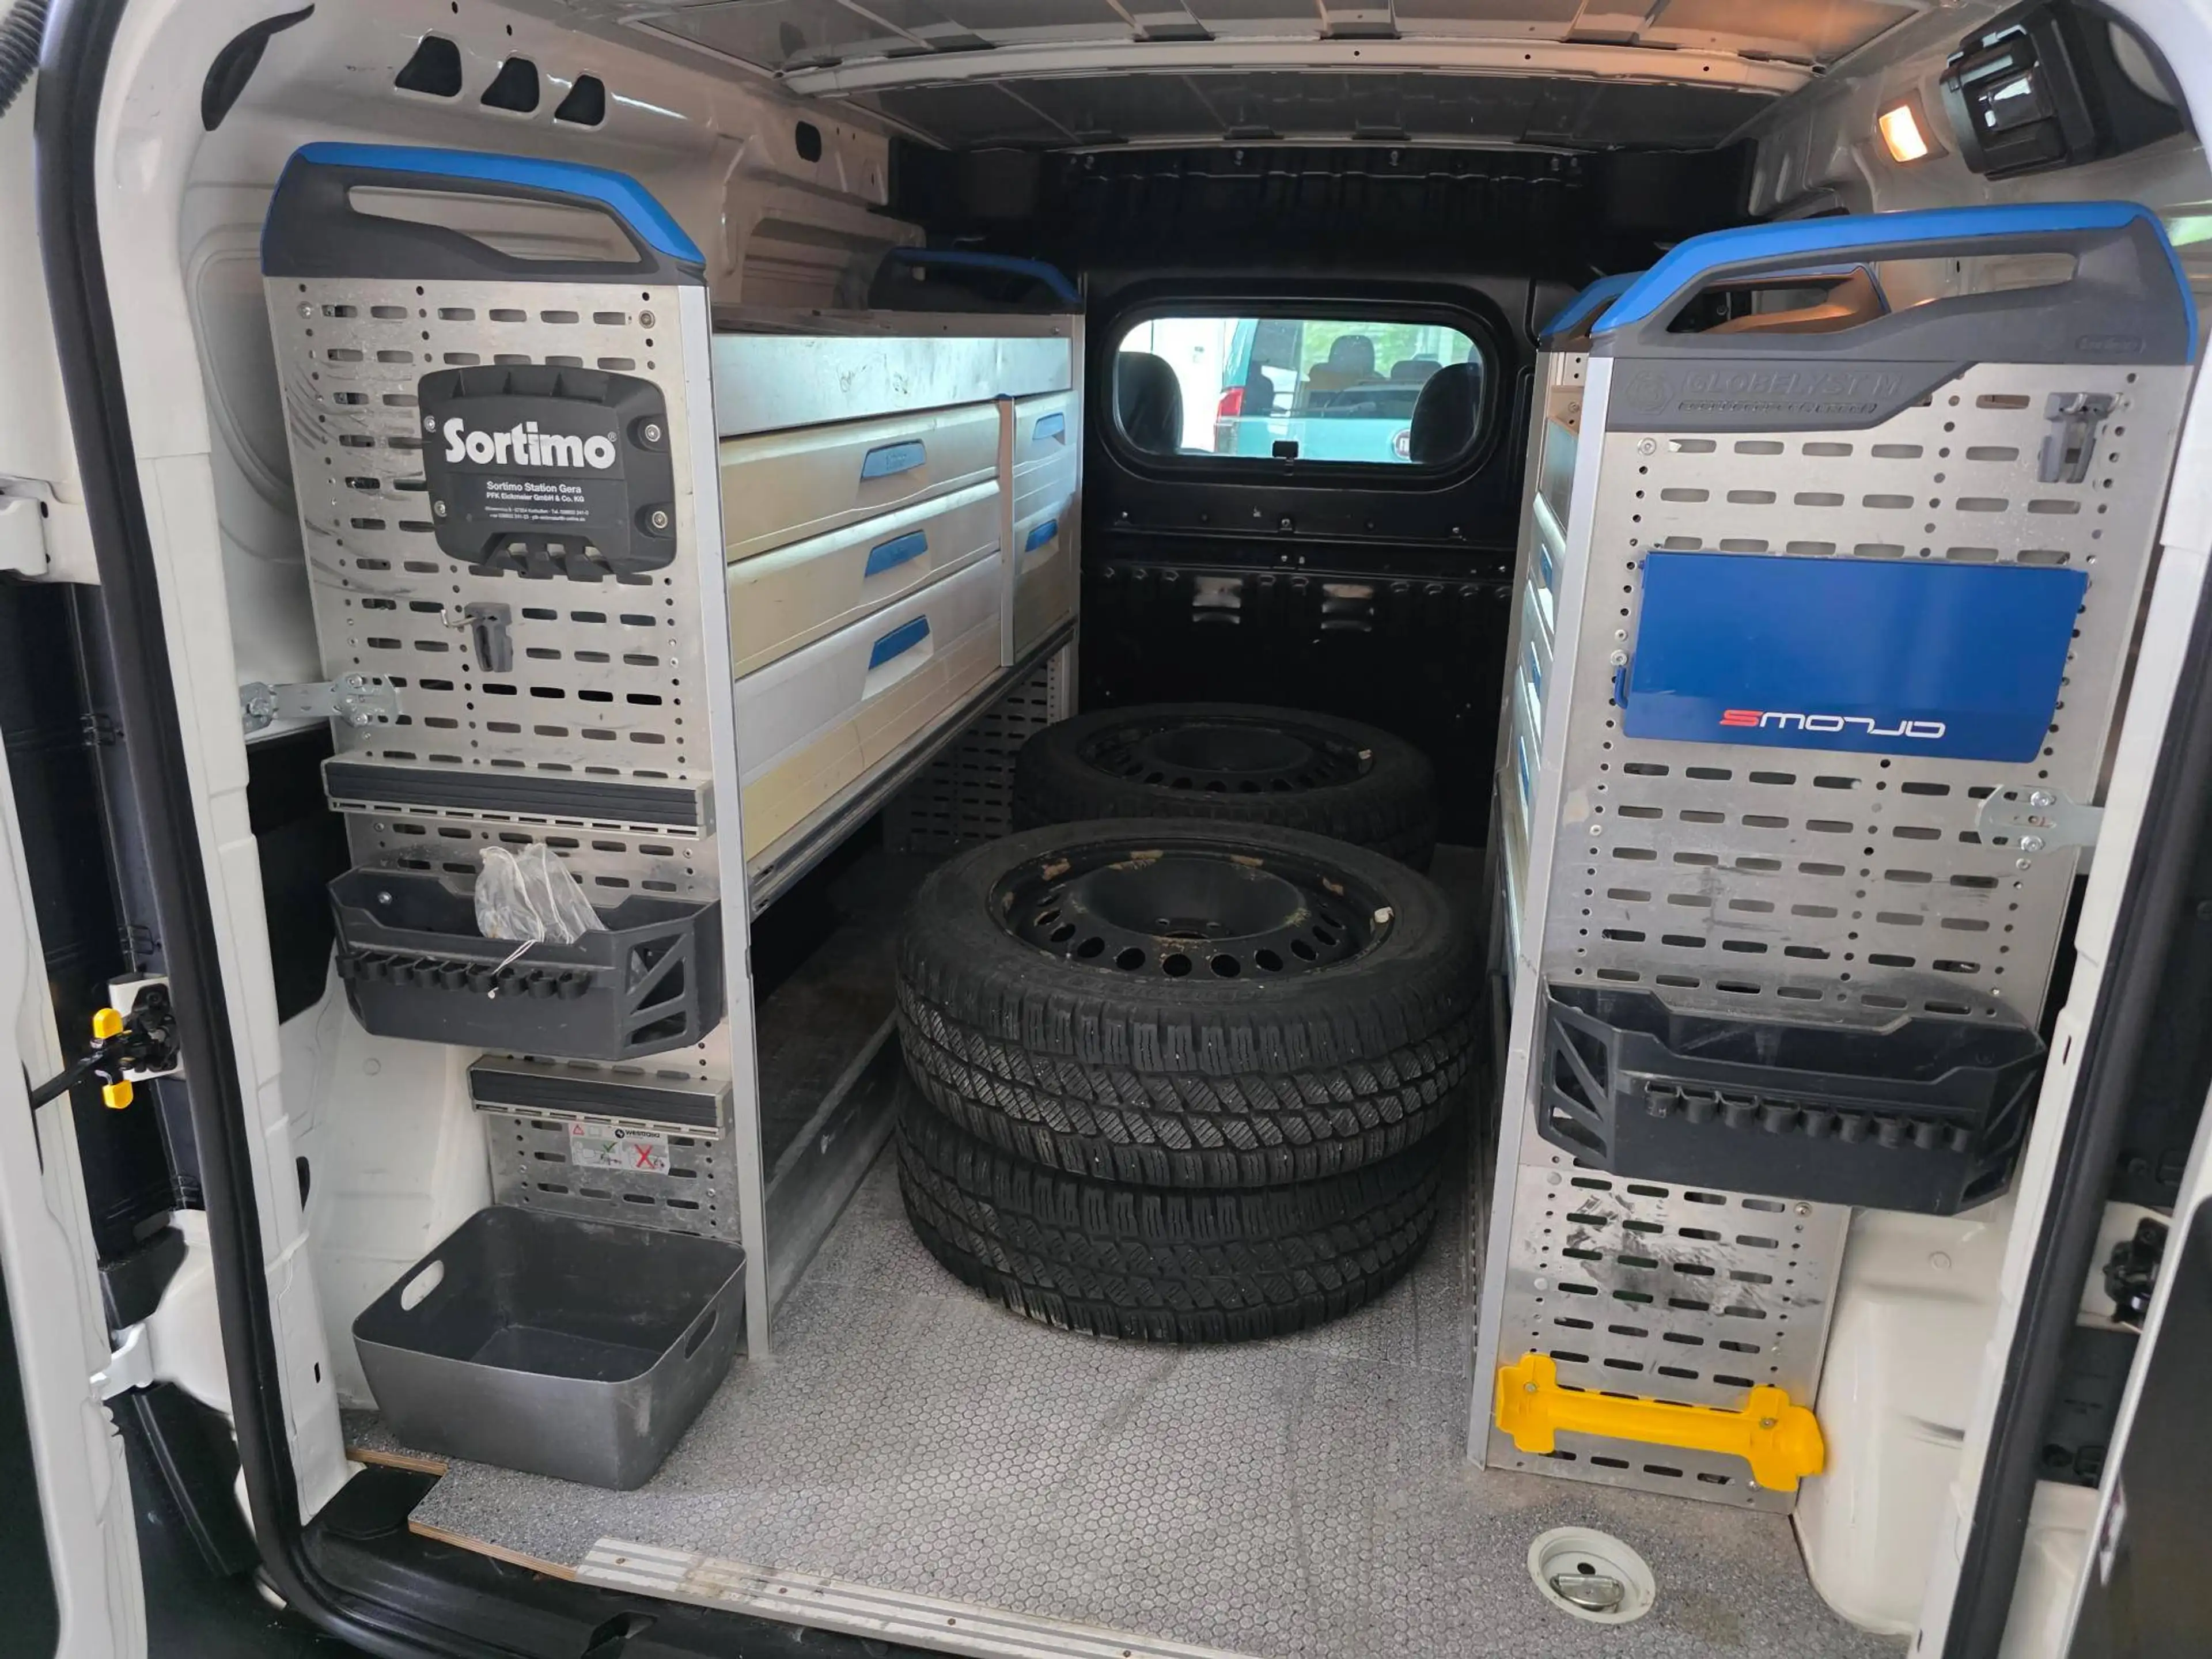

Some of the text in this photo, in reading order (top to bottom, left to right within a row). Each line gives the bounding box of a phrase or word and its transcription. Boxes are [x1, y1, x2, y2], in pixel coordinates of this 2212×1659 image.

[444, 418, 616, 469] Sortimo
[487, 481, 582, 493] Sortimo Station Gera
